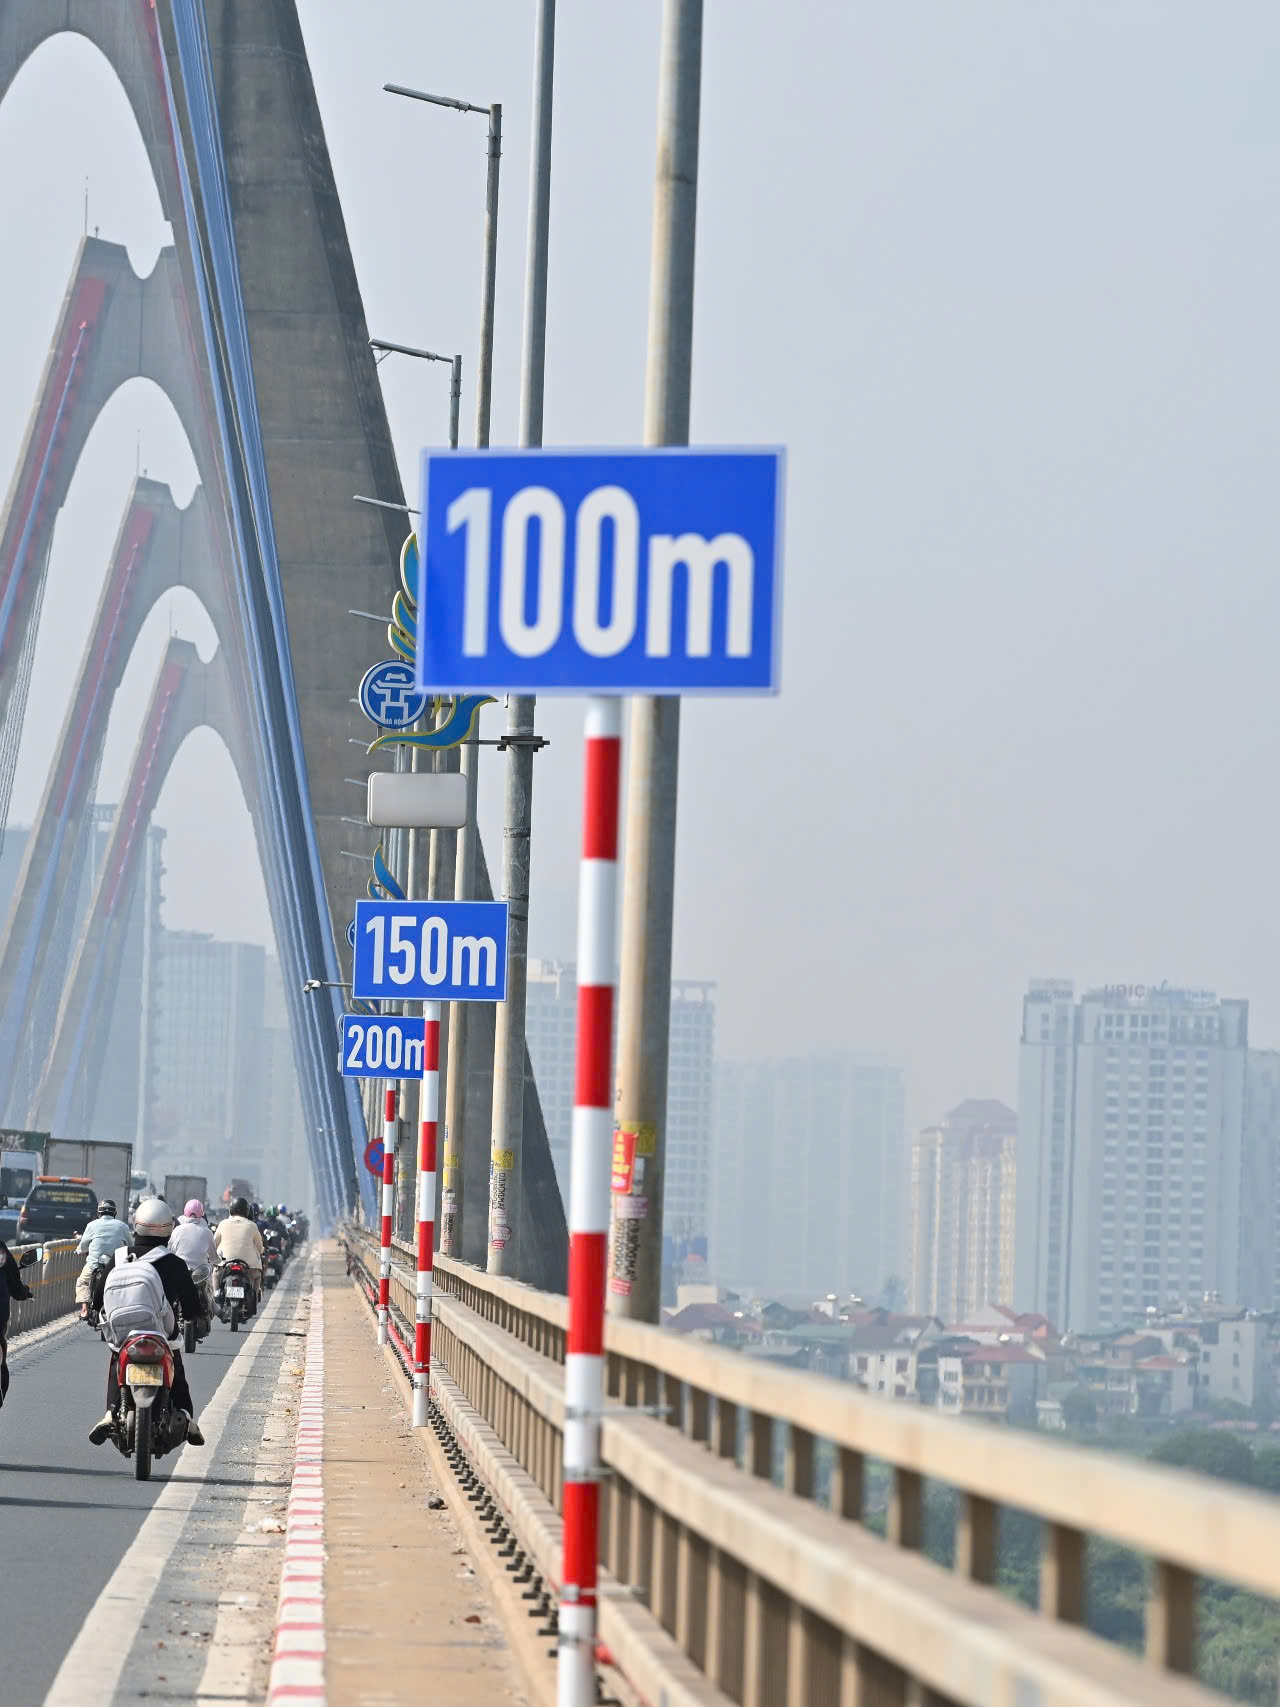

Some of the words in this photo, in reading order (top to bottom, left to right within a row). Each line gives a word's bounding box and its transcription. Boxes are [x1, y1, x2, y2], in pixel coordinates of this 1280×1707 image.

[446, 485, 755, 658] 100m
[366, 915, 497, 986] 150m
[346, 1024, 425, 1071] 200m
